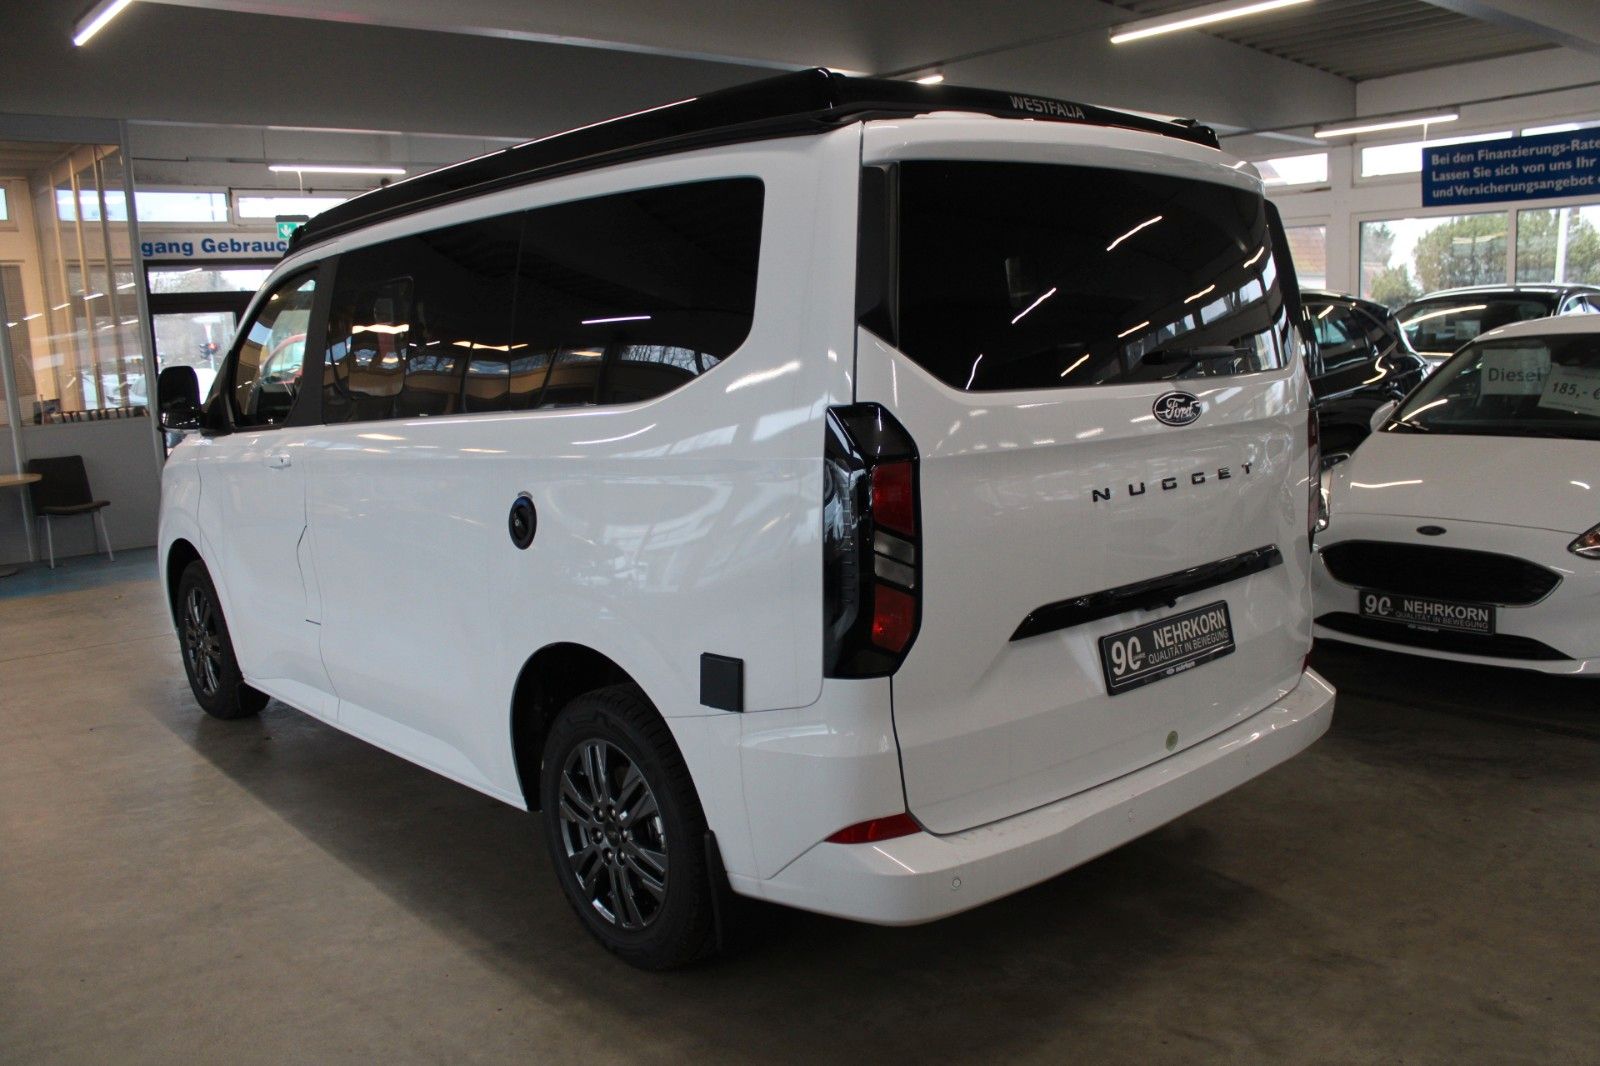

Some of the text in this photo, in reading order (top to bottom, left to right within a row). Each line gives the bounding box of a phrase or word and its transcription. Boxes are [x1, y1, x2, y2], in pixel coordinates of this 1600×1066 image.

[1010, 95, 1086, 120] WESTFALIA
[1431, 154, 1450, 166] Bei
[1453, 152, 1474, 164] den
[1432, 156, 1597, 182] Lassen Sie sich von uns Ihr
[1432, 185, 1454, 198] und
[1455, 174, 1594, 197] Versicherungsangebot
[1488, 367, 1542, 382] Diesel
[1157, 397, 1201, 420] Ford
[1092, 462, 1253, 502] NUGGET
[1404, 599, 1489, 622] NEHRKORN
[1153, 608, 1227, 650] NEHRKORN
[1148, 643, 1184, 665] QUALITÄT
[1184, 642, 1193, 653] IN
[1193, 628, 1229, 650] BEWEGUNG
